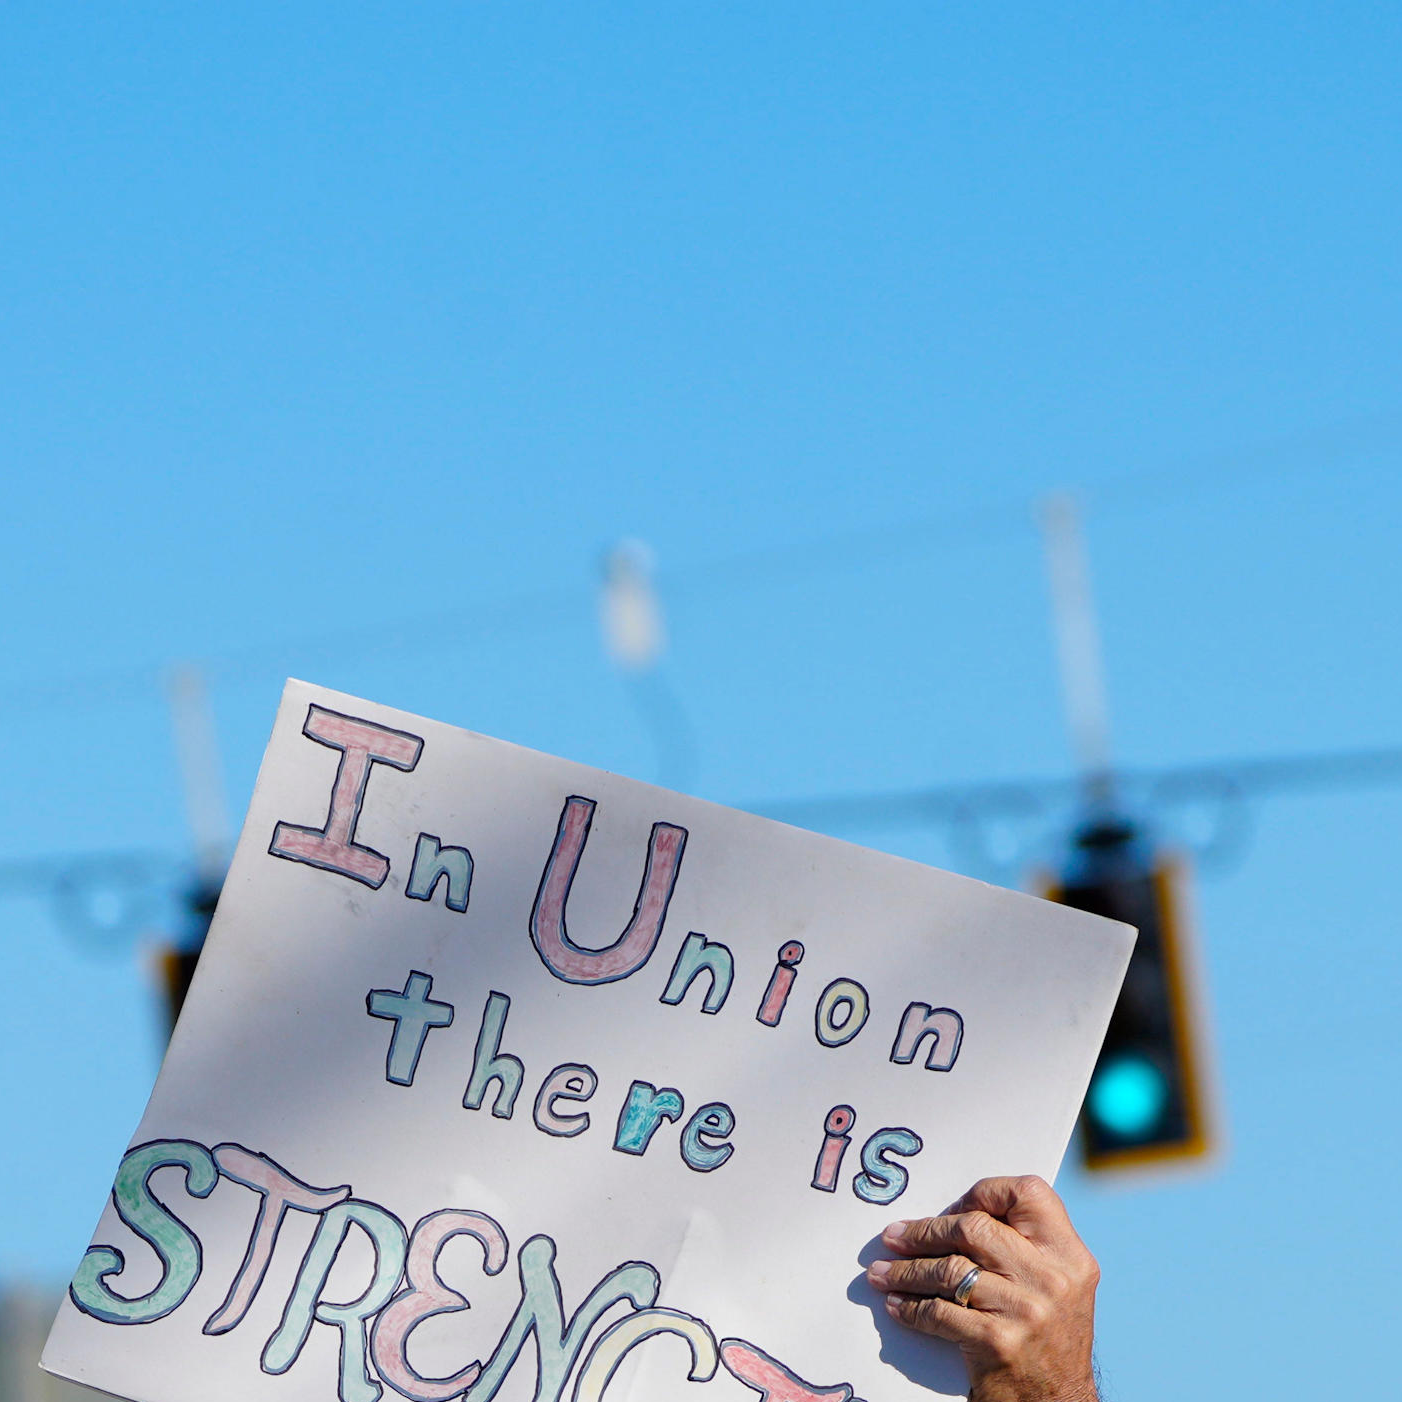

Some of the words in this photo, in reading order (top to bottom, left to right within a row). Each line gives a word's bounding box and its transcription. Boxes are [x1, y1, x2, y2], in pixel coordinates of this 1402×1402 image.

[267, 702, 475, 914] In
[528, 795, 965, 1073] Union
[367, 970, 736, 1173] there
[810, 1104, 924, 1206] is
